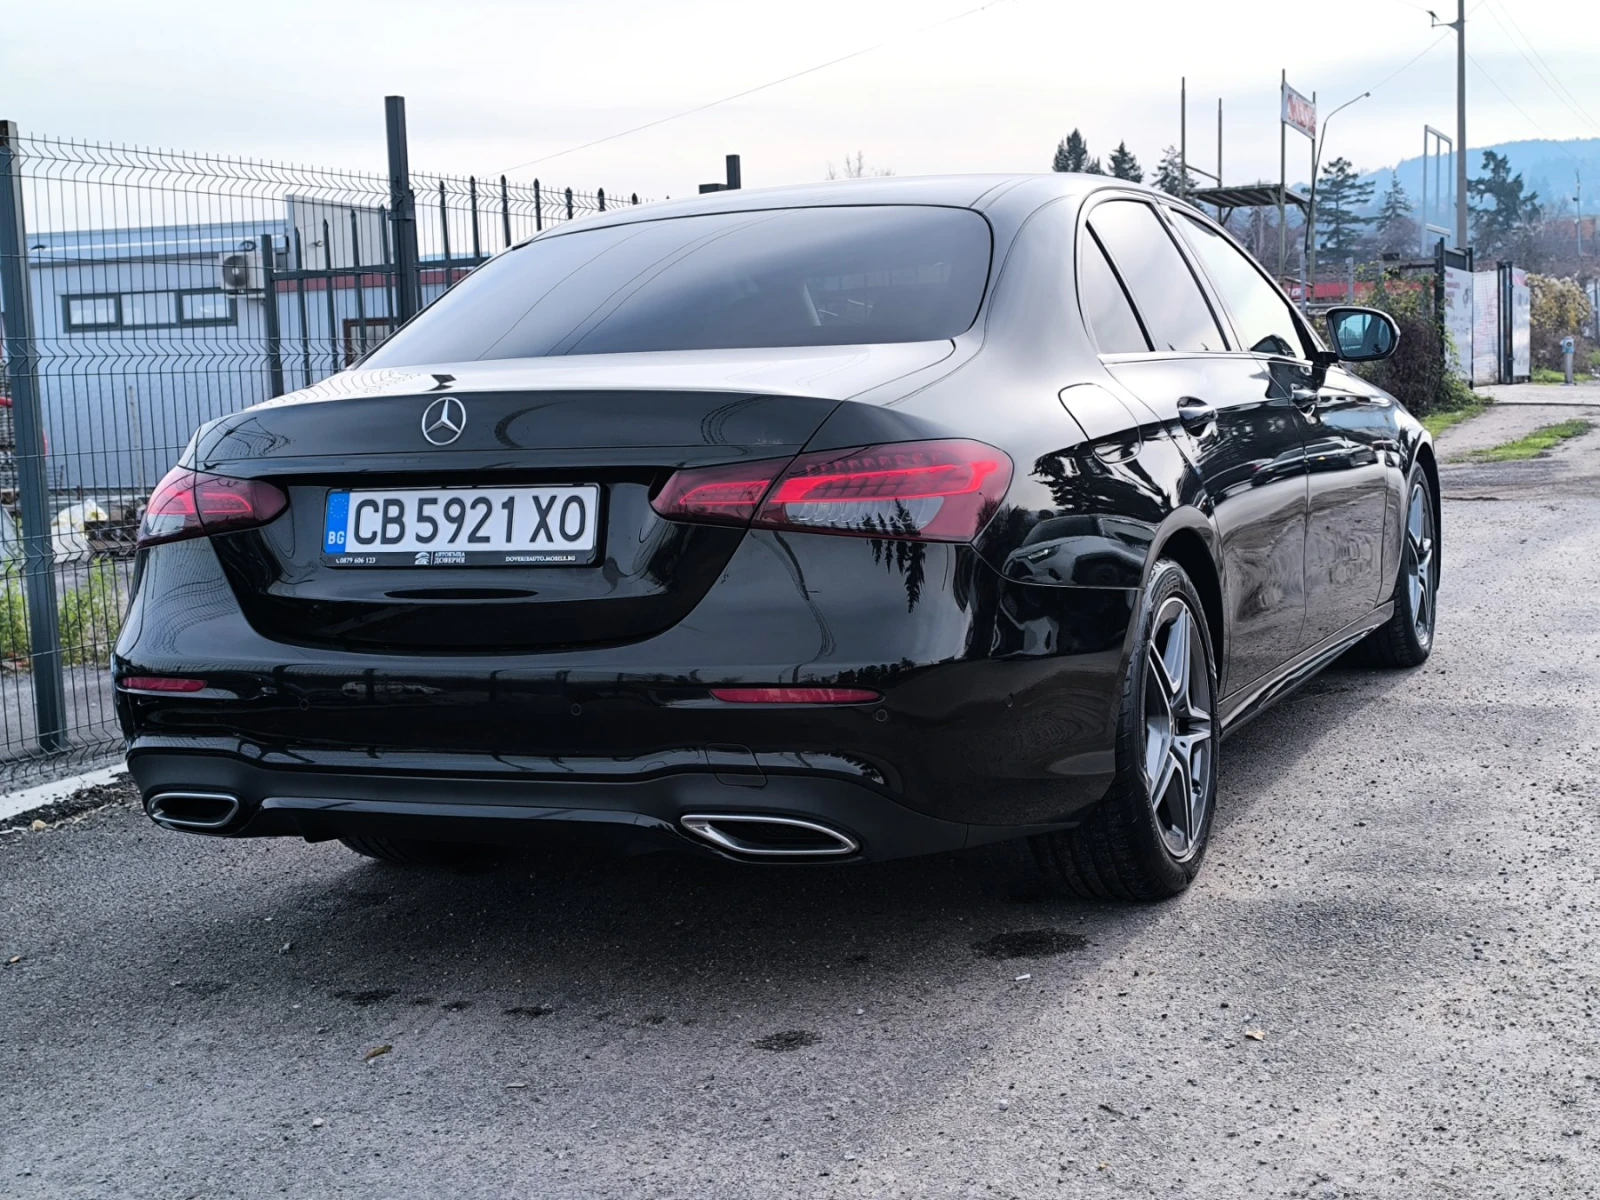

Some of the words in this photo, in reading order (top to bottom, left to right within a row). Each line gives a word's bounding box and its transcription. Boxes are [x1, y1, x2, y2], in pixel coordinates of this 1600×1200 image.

[353, 499, 406, 546] CB
[415, 495, 515, 545] 5921
[528, 495, 587, 543] XO
[328, 531, 345, 545] BG
[433, 557, 466, 565] ДОВЕРИЕ
